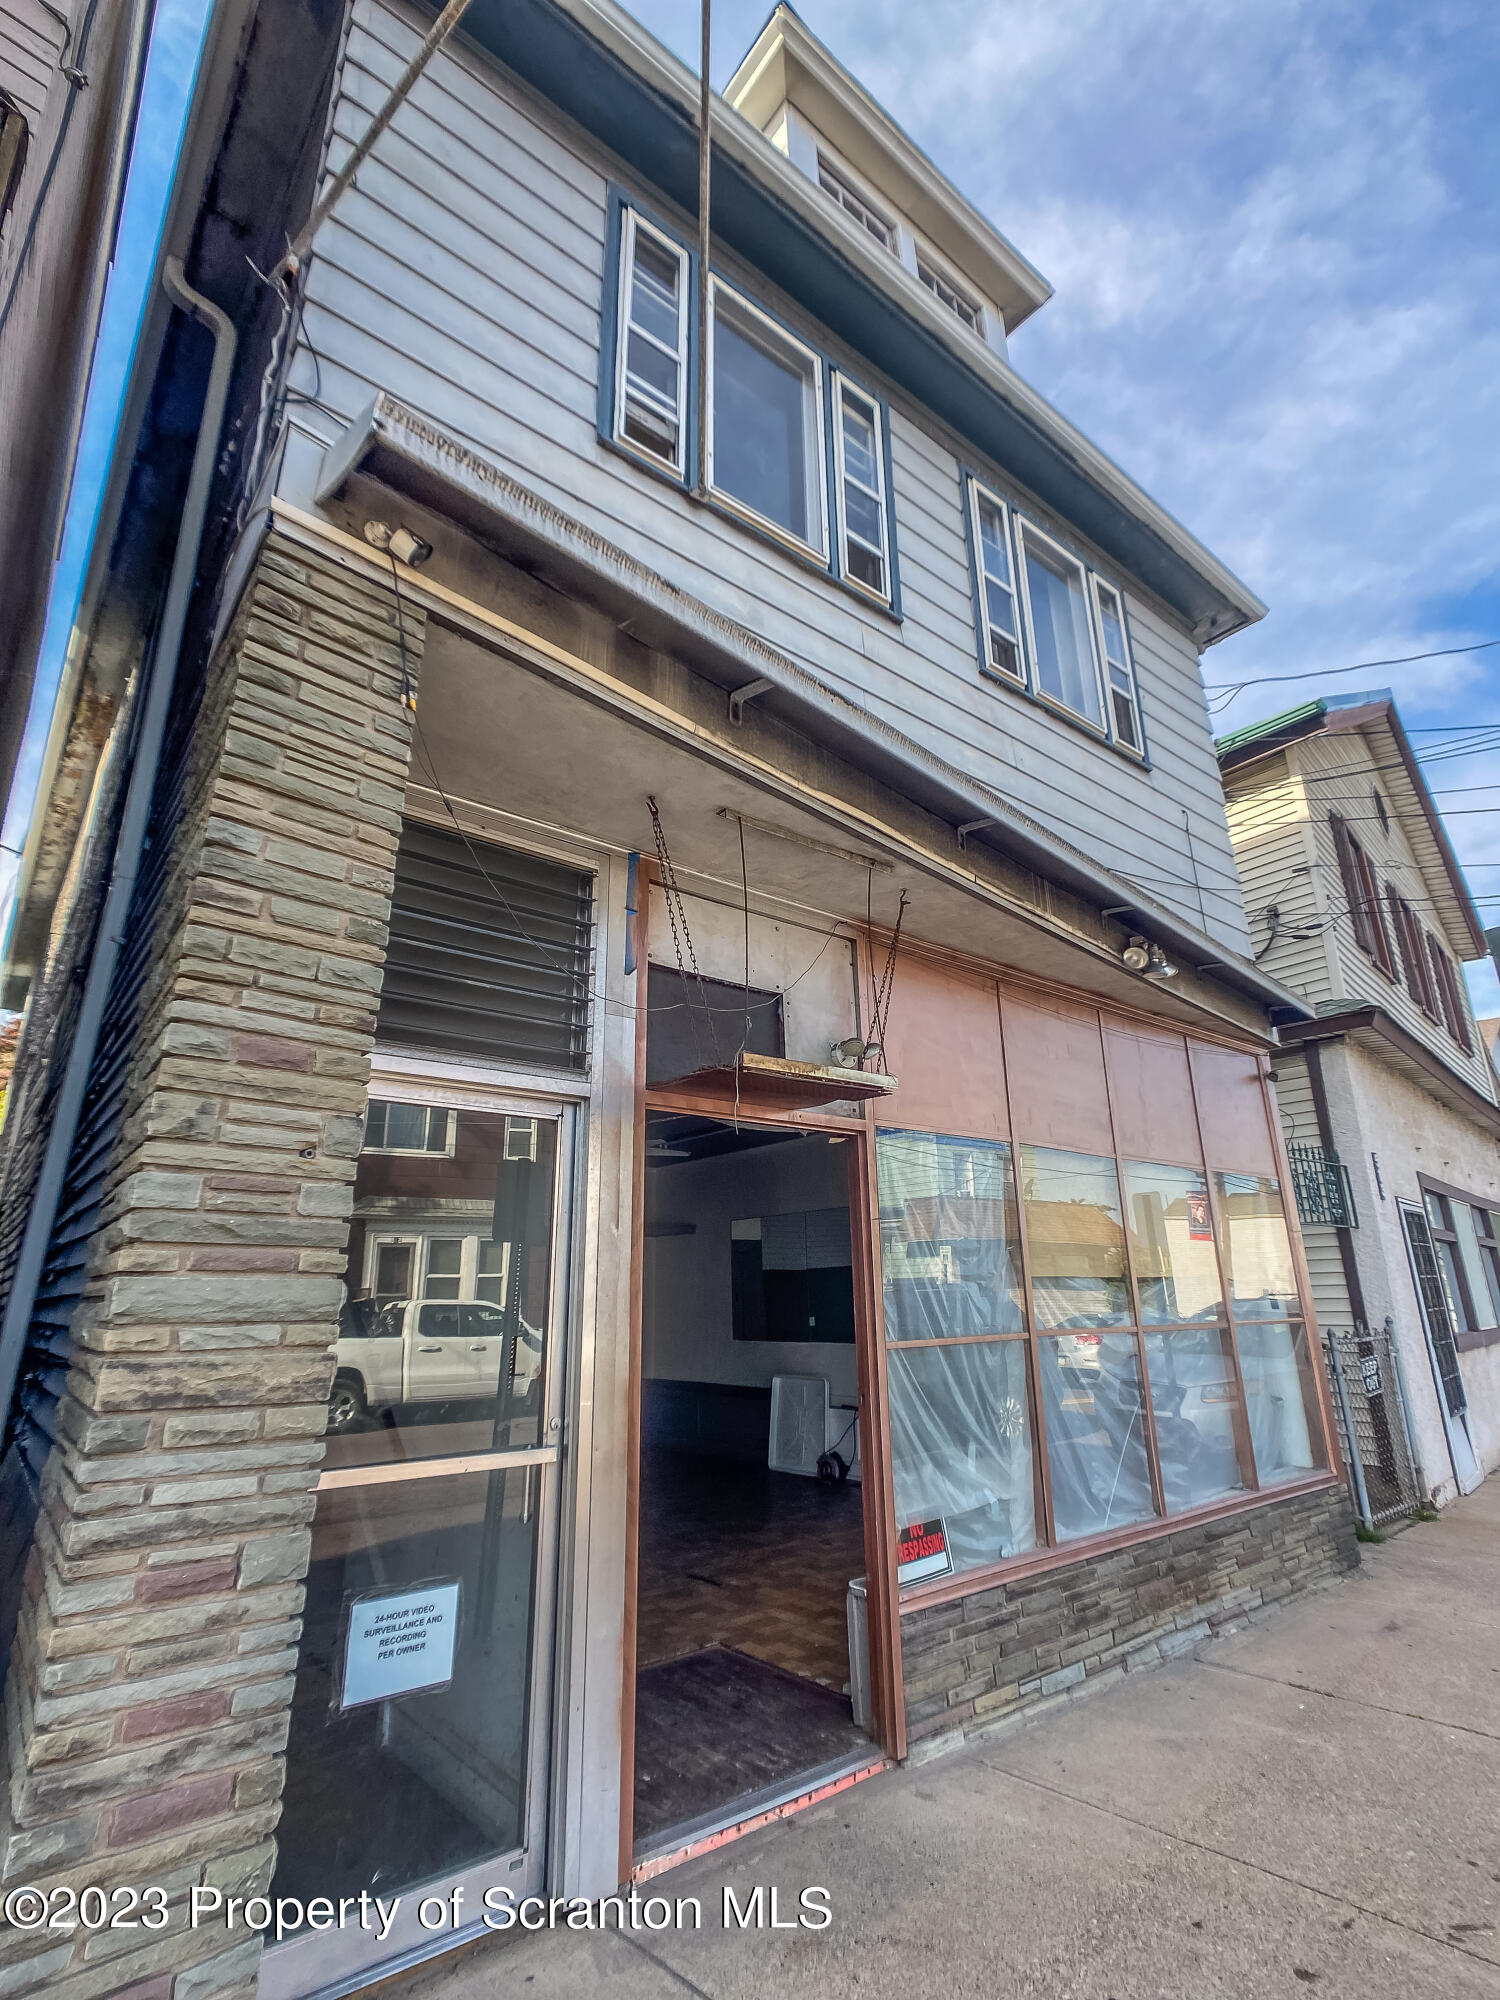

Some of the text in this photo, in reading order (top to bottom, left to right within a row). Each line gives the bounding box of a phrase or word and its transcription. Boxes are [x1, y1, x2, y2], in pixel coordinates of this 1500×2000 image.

[909, 1523, 924, 1538] NO
[897, 1532, 945, 1564] RESPASSING
[374, 1604, 435, 1624] 24-HOUR VIDEO
[363, 1615, 443, 1638] SURVEILLANCE AND
[378, 1630, 427, 1648] RECORDING
[377, 1642, 426, 1660] PER OWNER
